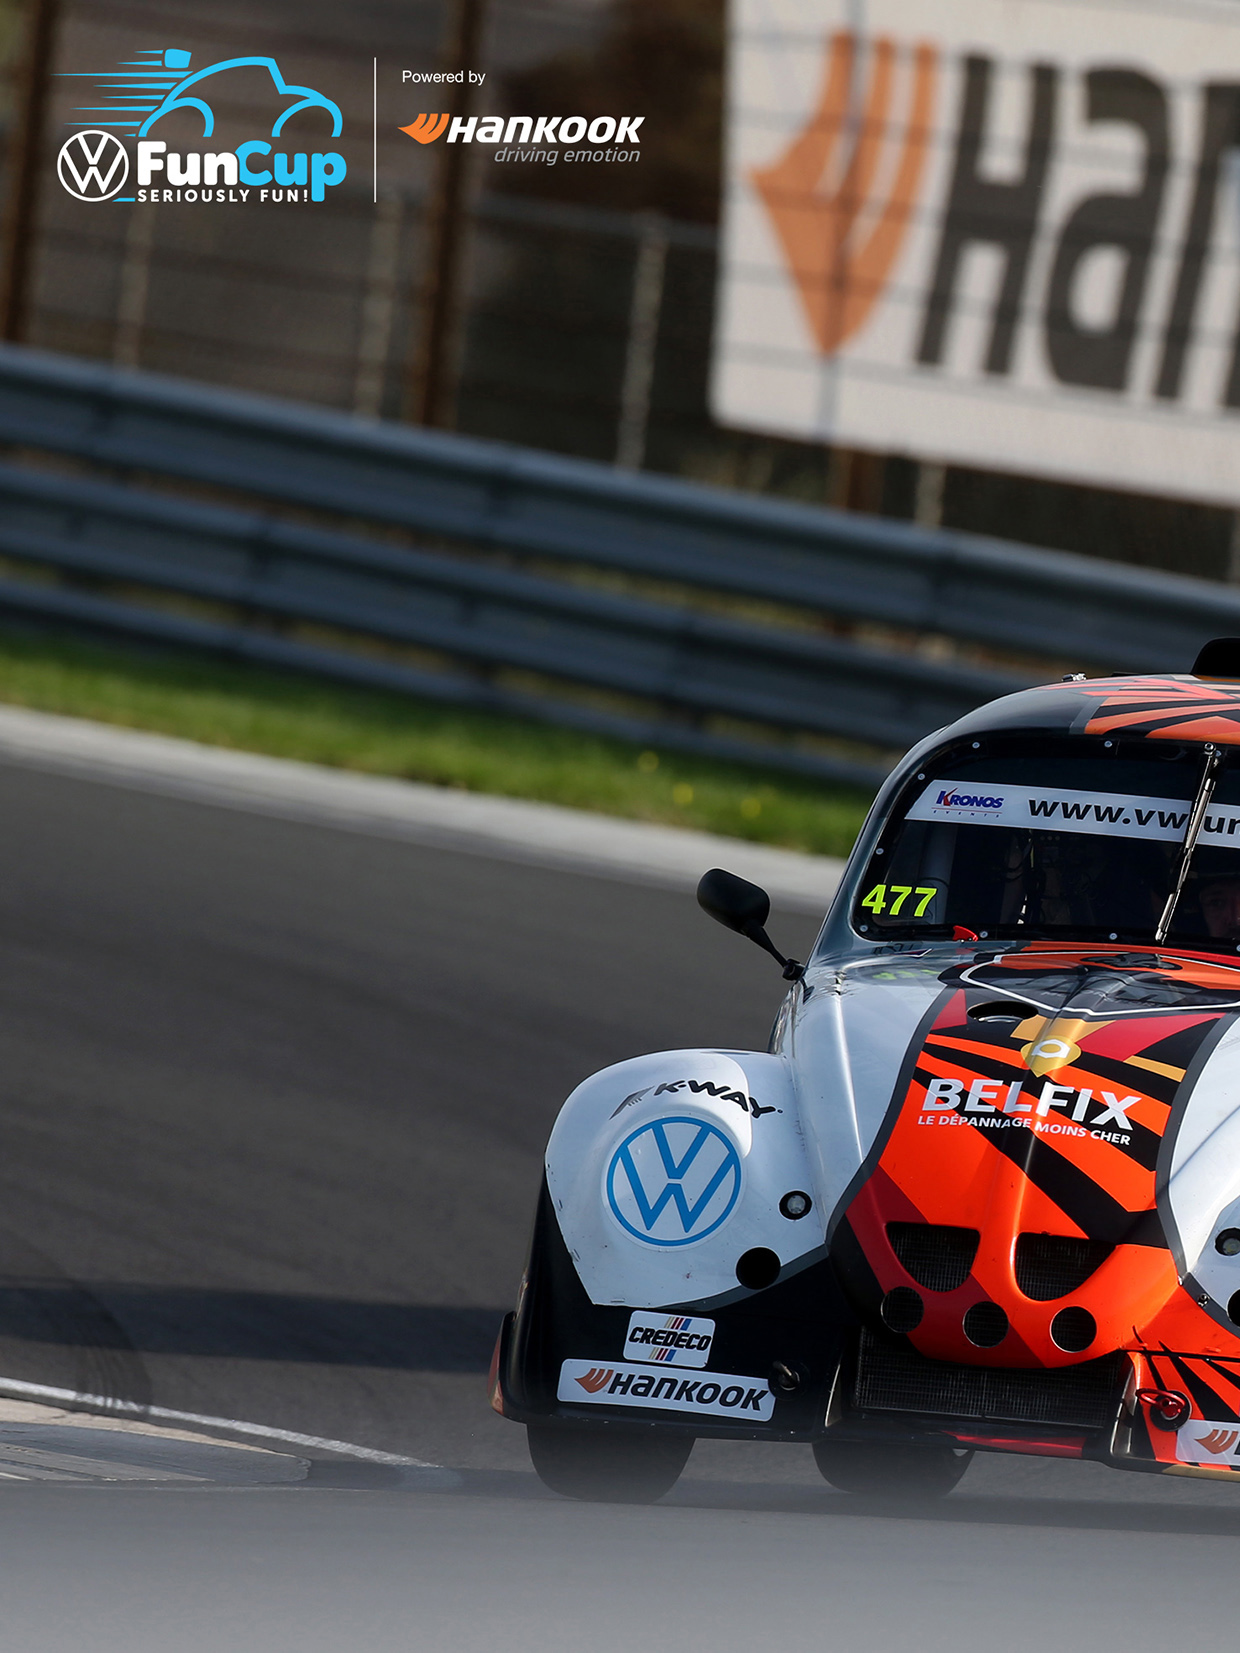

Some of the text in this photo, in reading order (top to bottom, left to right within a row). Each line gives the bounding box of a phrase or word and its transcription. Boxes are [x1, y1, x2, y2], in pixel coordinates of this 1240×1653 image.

[936, 786, 1005, 809] KRONOS
[861, 883, 938, 918] 477
[653, 1080, 776, 1119] K-WAY
[921, 1078, 1143, 1131] BELFIX
[917, 1113, 1132, 1146] LE DÉPANNAGE MOINS CHER
[628, 1326, 712, 1351] CREDECO
[607, 1372, 769, 1411] HANKOOK
